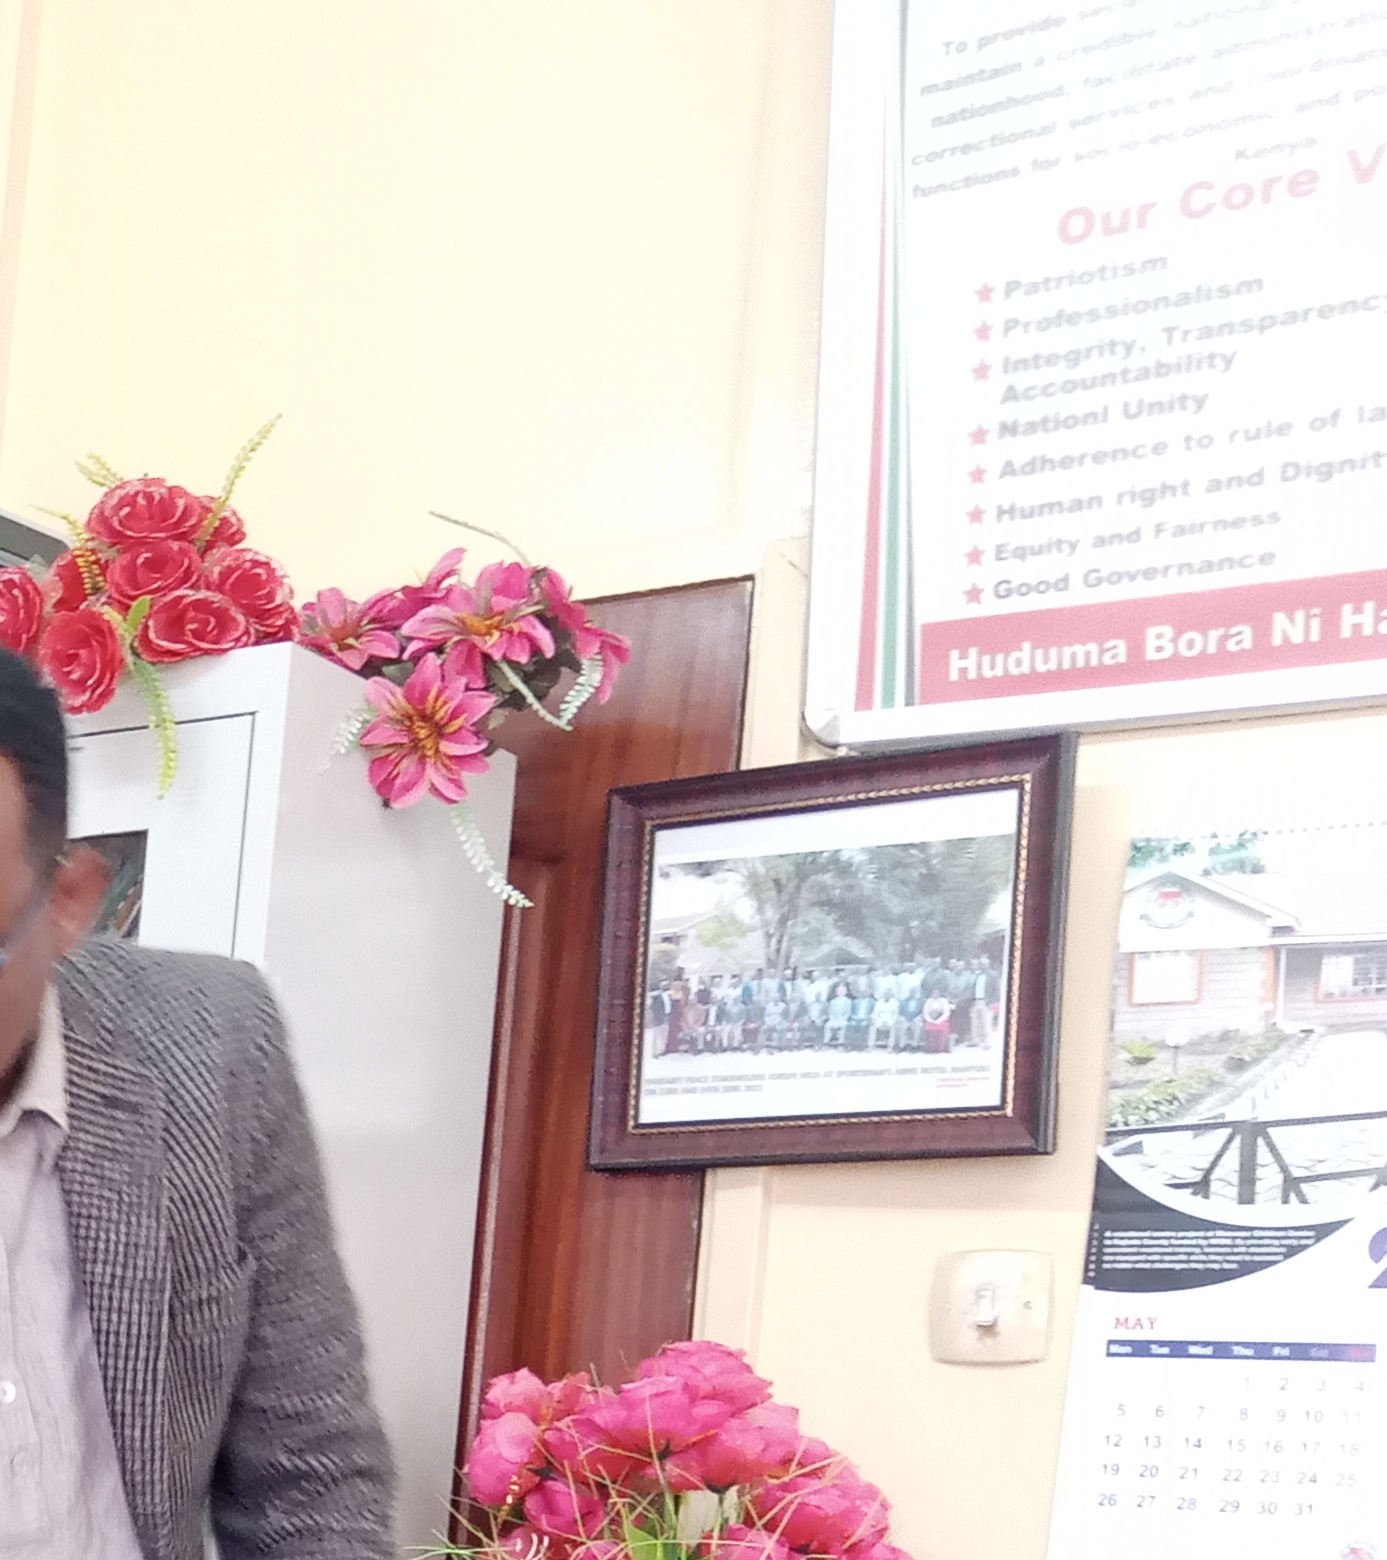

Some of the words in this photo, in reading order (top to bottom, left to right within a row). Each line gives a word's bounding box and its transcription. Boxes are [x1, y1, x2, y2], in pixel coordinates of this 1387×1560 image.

[942, 40, 968, 56] To
[976, 15, 1067, 52] provide
[920, 60, 1023, 97] maintain
[910, 120, 1057, 166] correctional
[1069, 96, 1176, 130] services
[912, 166, 1021, 199] functions
[1030, 155, 1062, 172] for
[1294, 90, 1341, 114] and
[1057, 201, 1158, 245] Our
[1179, 168, 1321, 220] Core
[1003, 256, 1168, 301] Patriotism
[1002, 277, 1265, 339] Professionalism
[999, 351, 1237, 405] Accountability
[1001, 337, 1147, 376] Integrity,
[997, 403, 1109, 440] Nationl
[1122, 392, 1209, 421] Unity
[998, 439, 1169, 480] Adherence
[1183, 433, 1214, 451] to
[1228, 419, 1294, 445] rule
[1308, 407, 1342, 433] of
[995, 494, 1103, 523] Human
[1116, 478, 1191, 509] right
[1204, 467, 1266, 494] and
[993, 535, 1081, 562] Equity
[1091, 526, 1142, 549] and
[1153, 509, 1282, 540] Fairness
[992, 572, 1070, 600] Good
[1082, 550, 1277, 589] Governance
[948, 637, 1127, 682] Huduma
[1144, 622, 1254, 662] Bora
[1271, 608, 1323, 647] Ni
[1114, 1316, 1158, 1330] MAY
[1279, 1377, 1289, 1392] 2
[1117, 1403, 1126, 1417] 5
[1155, 1404, 1165, 1418] 6
[1197, 1405, 1205, 1419] 7
[1238, 1407, 1249, 1421] 8
[1276, 1408, 1286, 1422] 9
[1304, 1409, 1324, 1424] 10
[1105, 1433, 1123, 1448] 12
[1143, 1434, 1162, 1449] 13
[1184, 1436, 1203, 1450] 14
[1227, 1438, 1247, 1452] 15
[1264, 1440, 1284, 1454] 16
[1102, 1462, 1120, 1477] 19
[1138, 1464, 1159, 1479] 20
[1178, 1466, 1198, 1480] 21
[1222, 1468, 1244, 1483] 22
[1259, 1469, 1281, 1484] 23
[1296, 1471, 1318, 1486] 24
[1097, 1492, 1118, 1507] 26
[1135, 1494, 1156, 1509] 27
[1176, 1496, 1197, 1511] 28
[1218, 1499, 1241, 1514] 29
[1257, 1501, 1278, 1516] 30
[1293, 1503, 1313, 1517] 31
